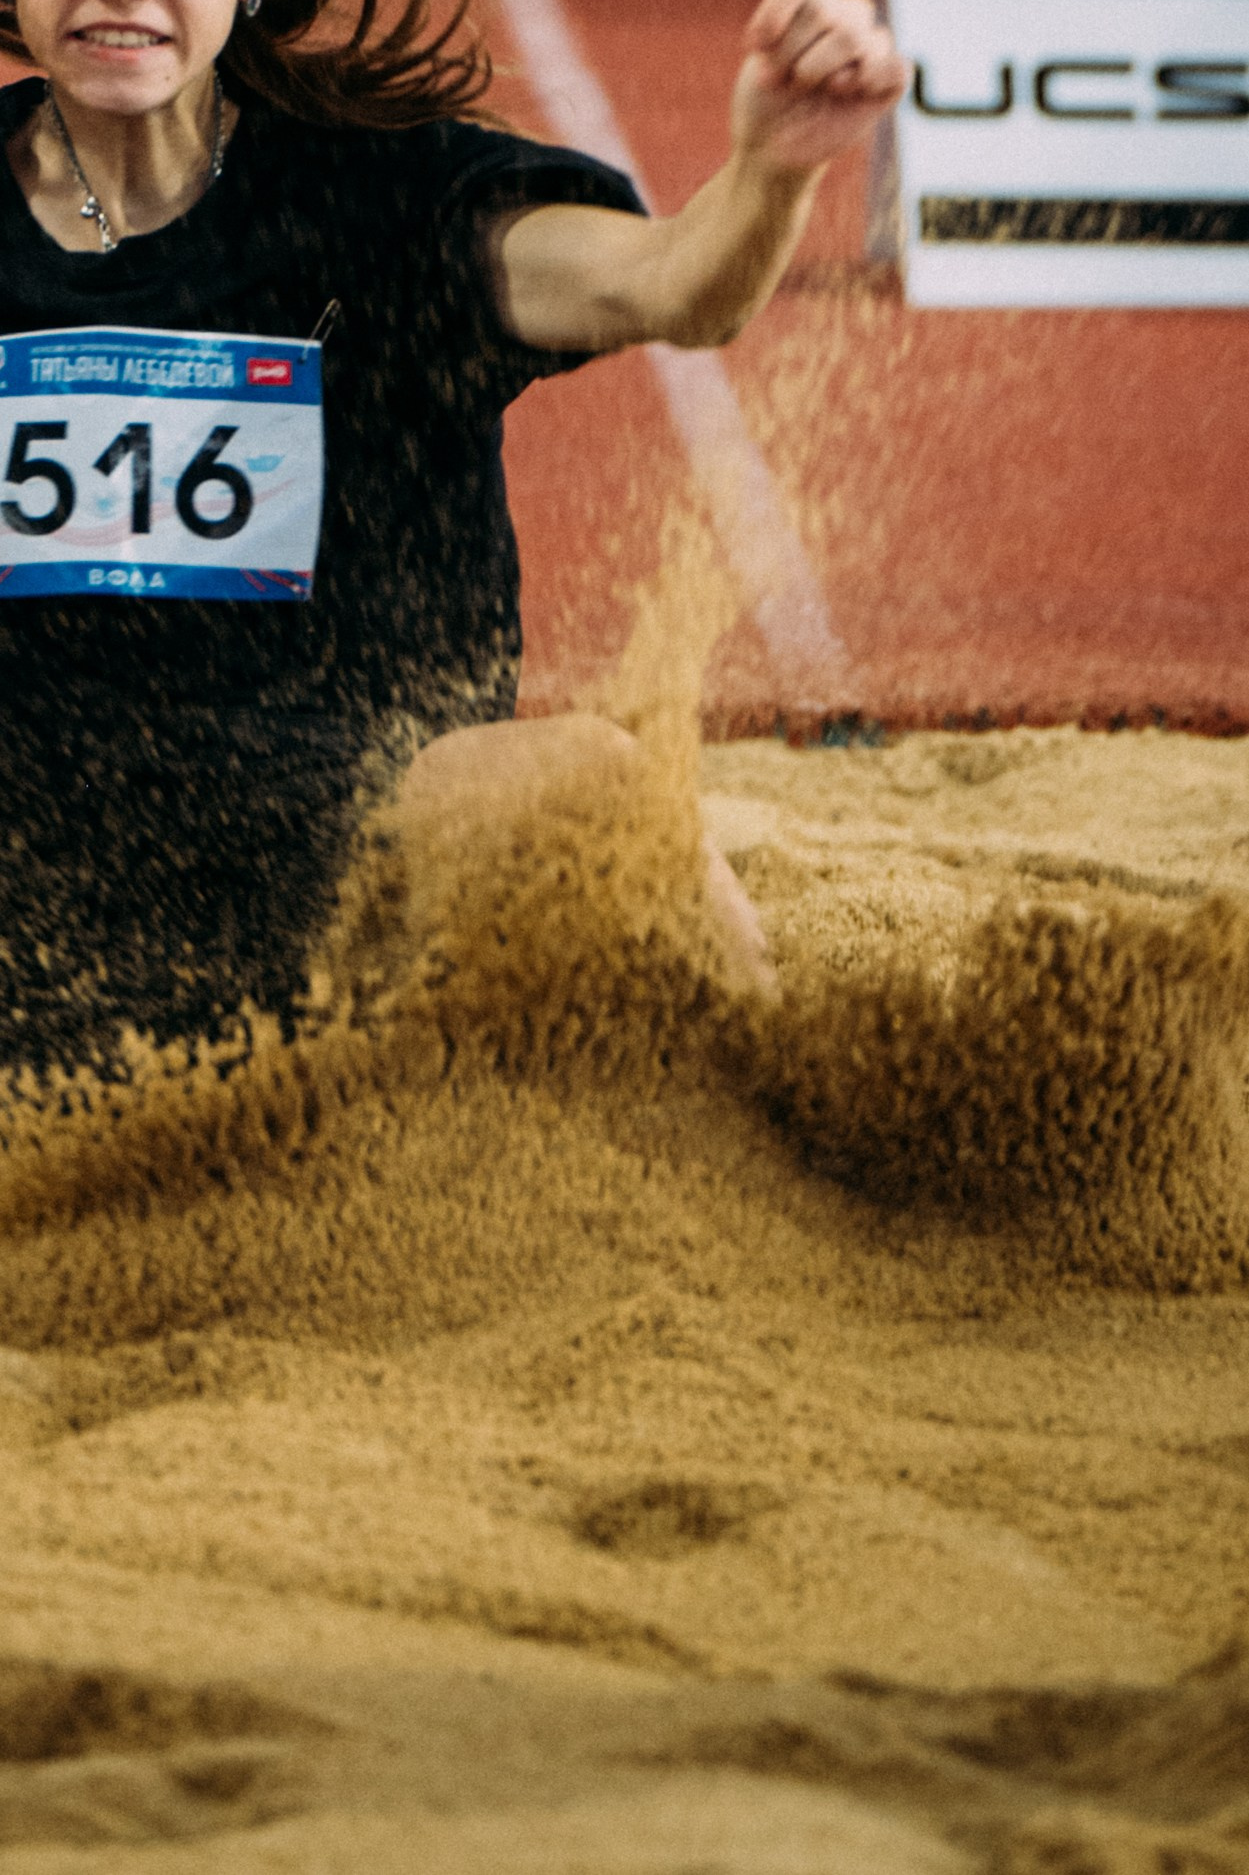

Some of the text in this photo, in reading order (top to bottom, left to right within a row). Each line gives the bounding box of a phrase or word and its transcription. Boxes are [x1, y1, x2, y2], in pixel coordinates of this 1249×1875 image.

[913, 60, 1249, 121] UCS
[30, 356, 119, 383] ТАТЬЯНЫ
[0, 420, 255, 541] 516
